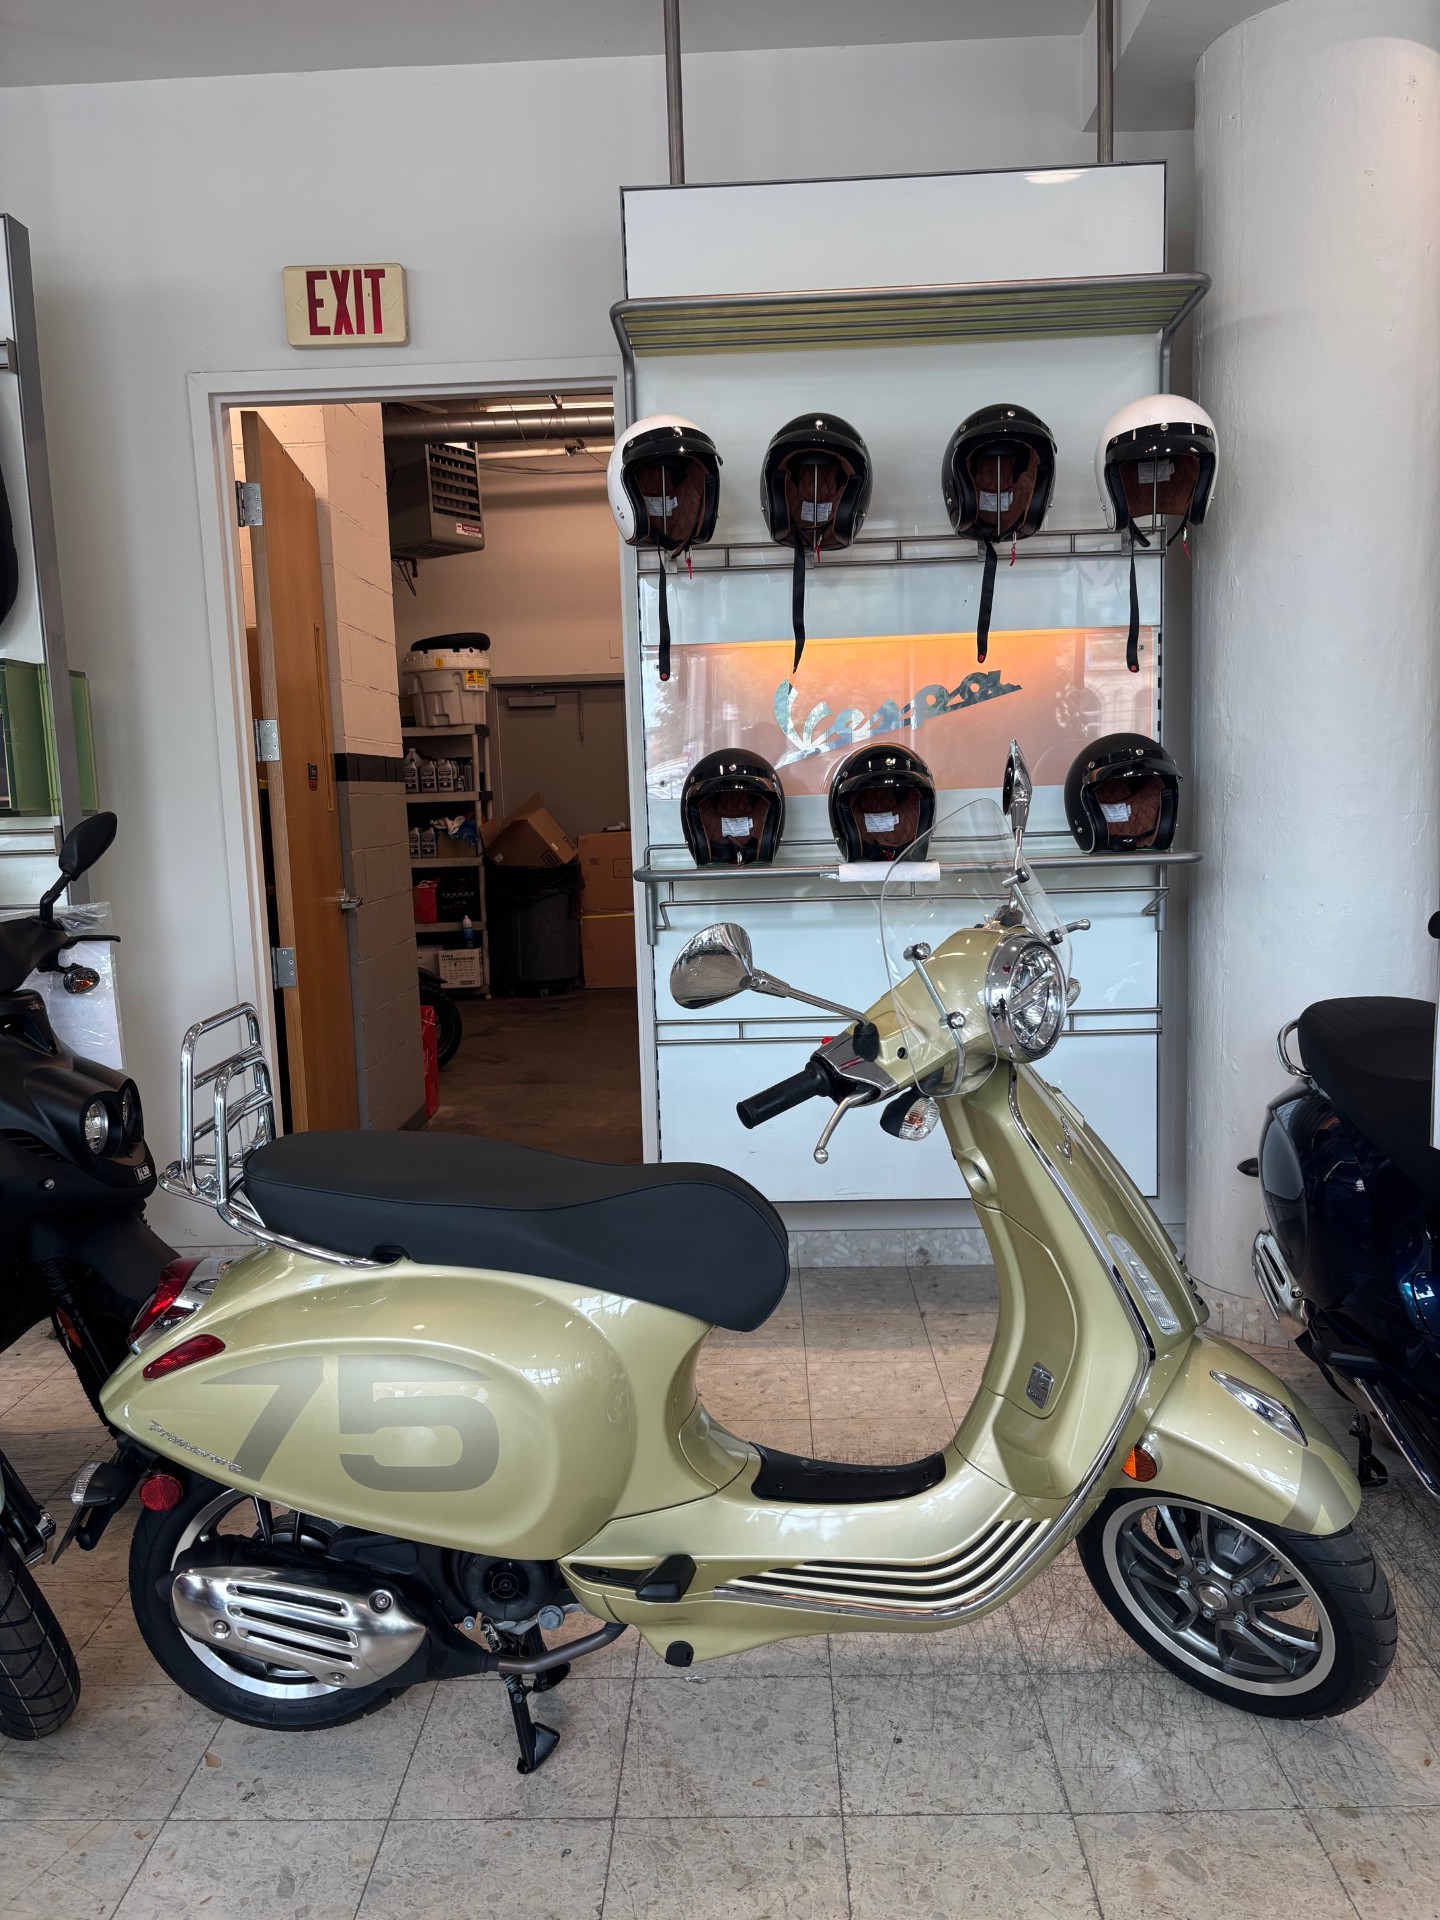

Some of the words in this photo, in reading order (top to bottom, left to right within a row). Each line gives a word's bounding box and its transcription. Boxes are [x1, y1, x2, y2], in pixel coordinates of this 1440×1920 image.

[305, 268, 386, 336] EXIT
[773, 669, 1023, 770] Vespa
[148, 1419, 242, 1472] Primavera
[200, 1354, 500, 1492] 75
